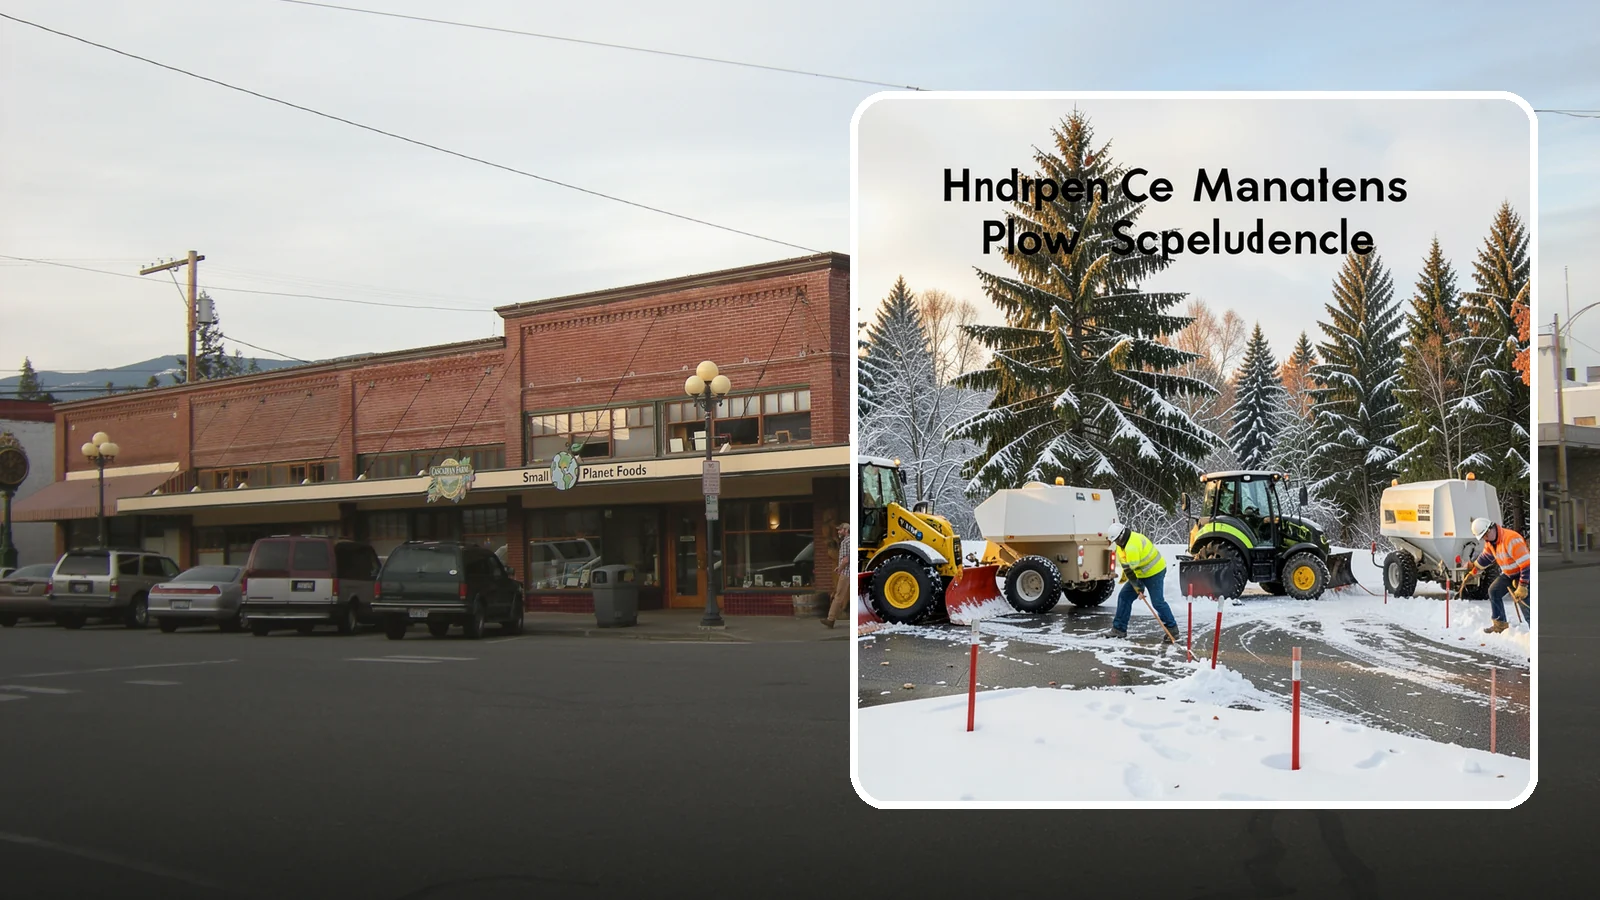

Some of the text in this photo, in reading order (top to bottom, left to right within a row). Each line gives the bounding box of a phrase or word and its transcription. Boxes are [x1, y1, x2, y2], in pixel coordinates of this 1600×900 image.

[523, 464, 647, 483] Small Planet Foods
